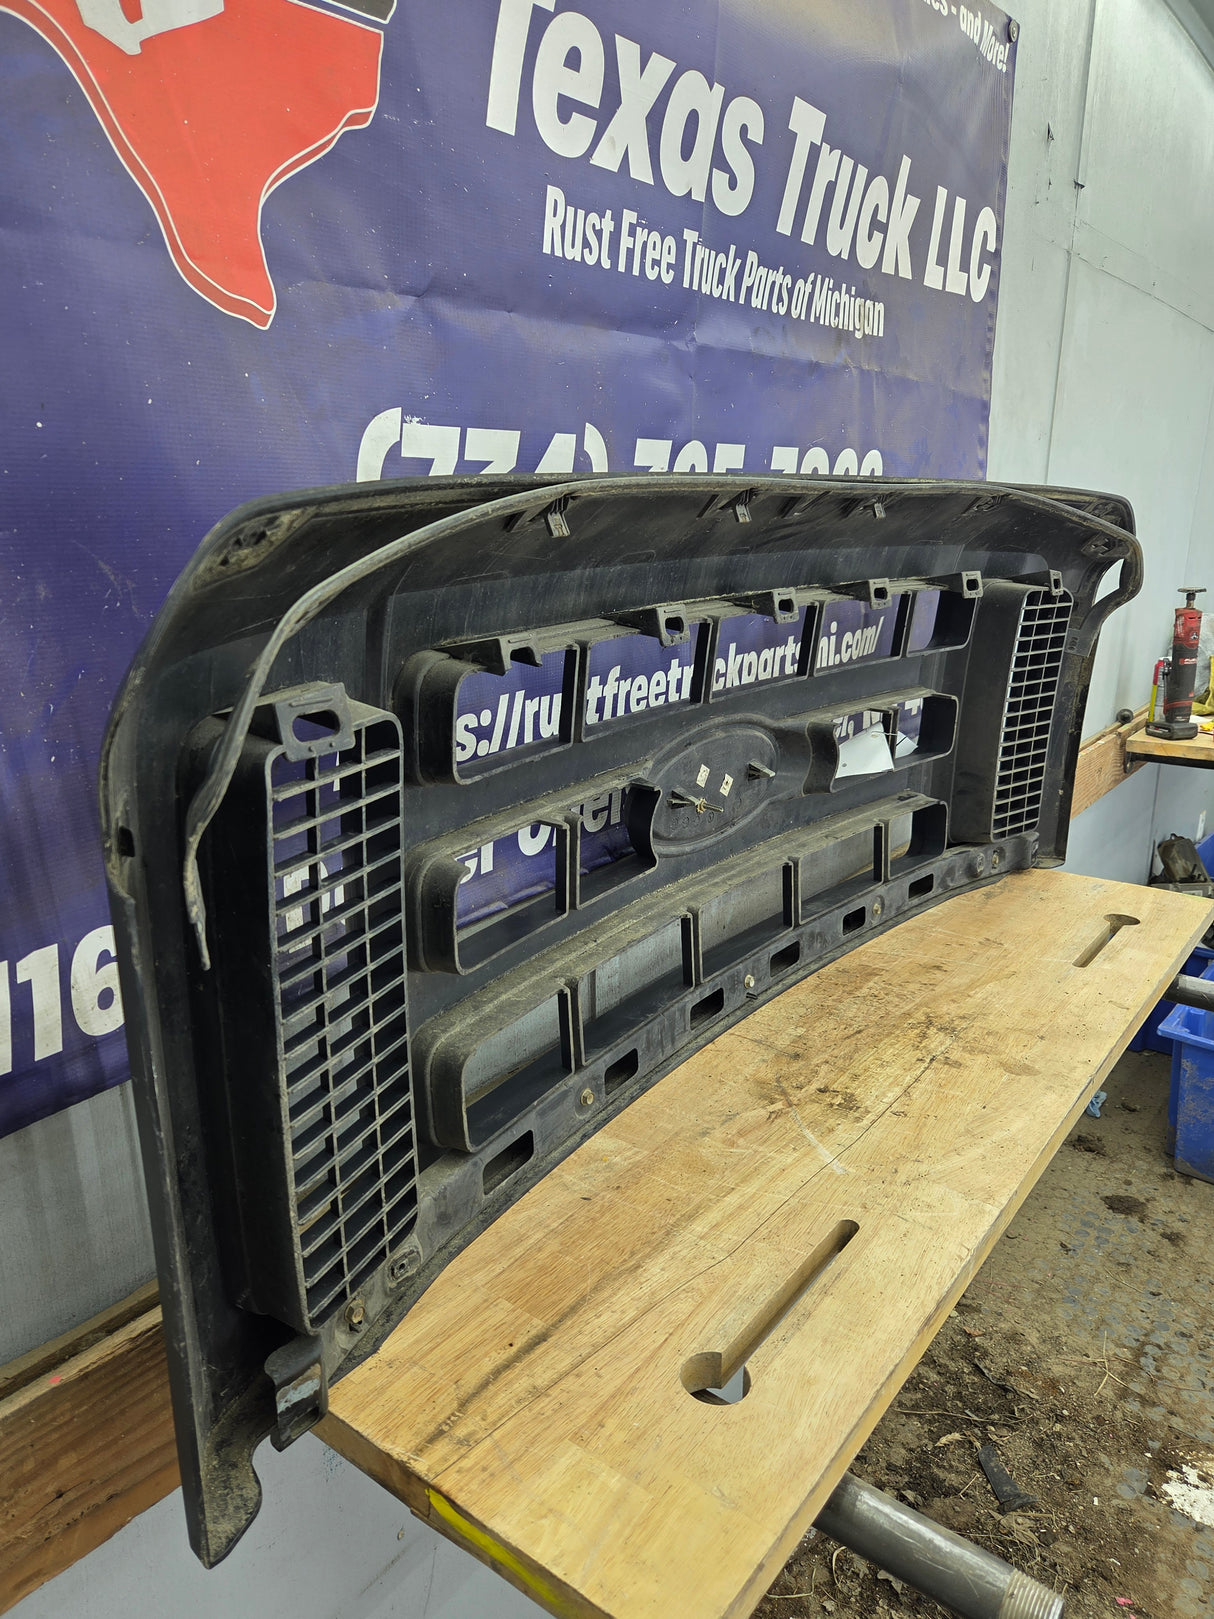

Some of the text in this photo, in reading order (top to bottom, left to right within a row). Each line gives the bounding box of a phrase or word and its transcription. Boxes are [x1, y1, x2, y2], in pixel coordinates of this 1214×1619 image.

[959, 4, 982, 46] and
[979, 19, 1010, 73] More!
[485, 0, 998, 304] Texas Truck LLC
[542, 184, 886, 340] Rust Free Truck Parts of Michigan
[0, 924, 126, 1077] 16
